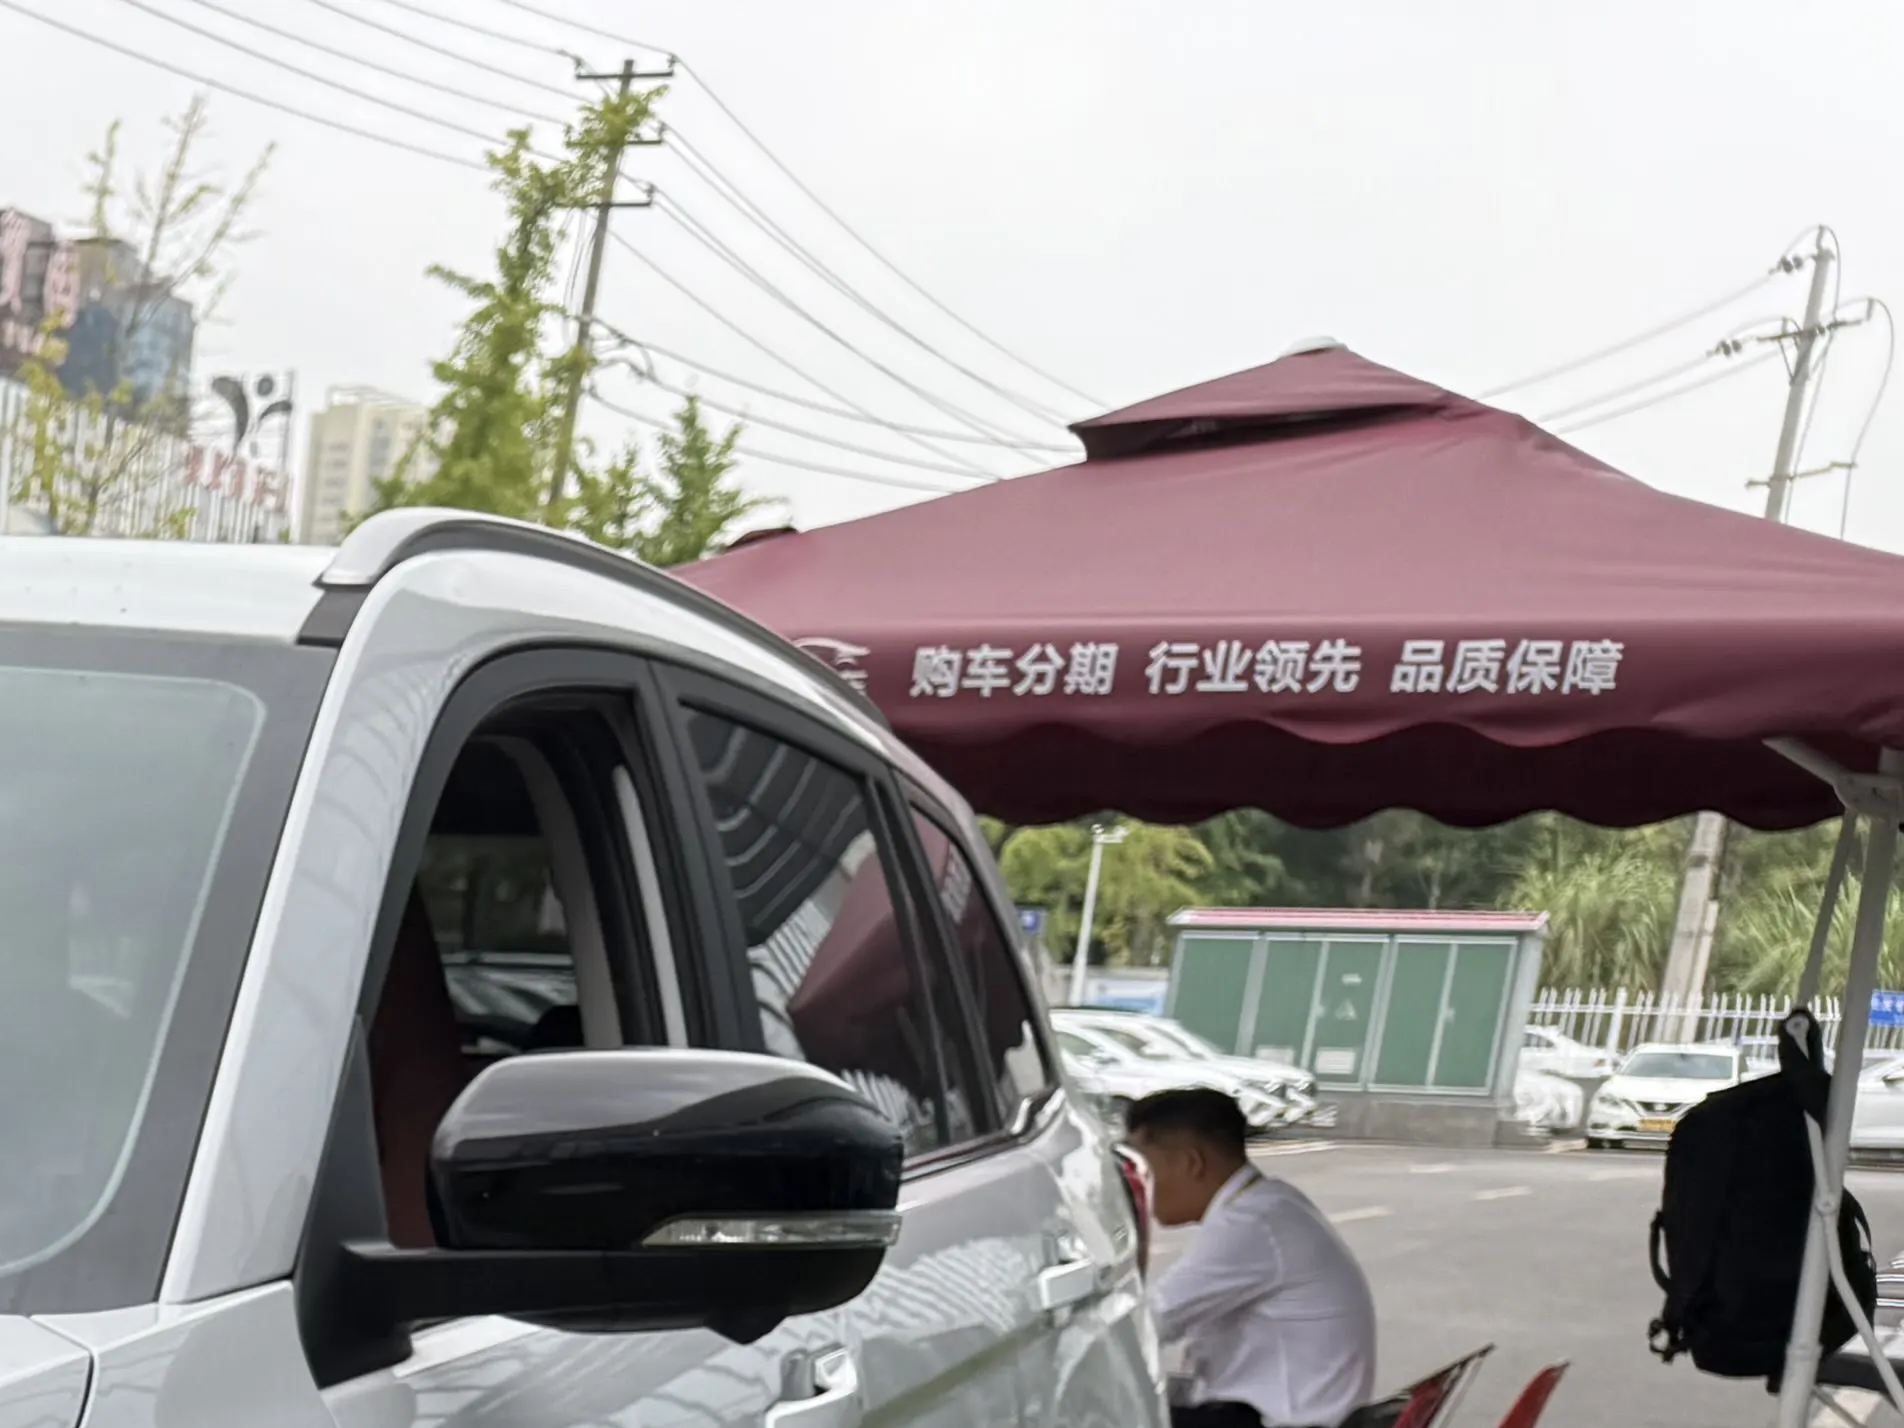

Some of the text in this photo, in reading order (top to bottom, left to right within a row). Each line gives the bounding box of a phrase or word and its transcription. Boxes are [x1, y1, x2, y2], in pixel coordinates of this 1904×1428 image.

[908, 642, 1120, 698] 购车分期
[1144, 638, 1363, 695] 行业领先
[1389, 638, 1625, 696] 品质保障
